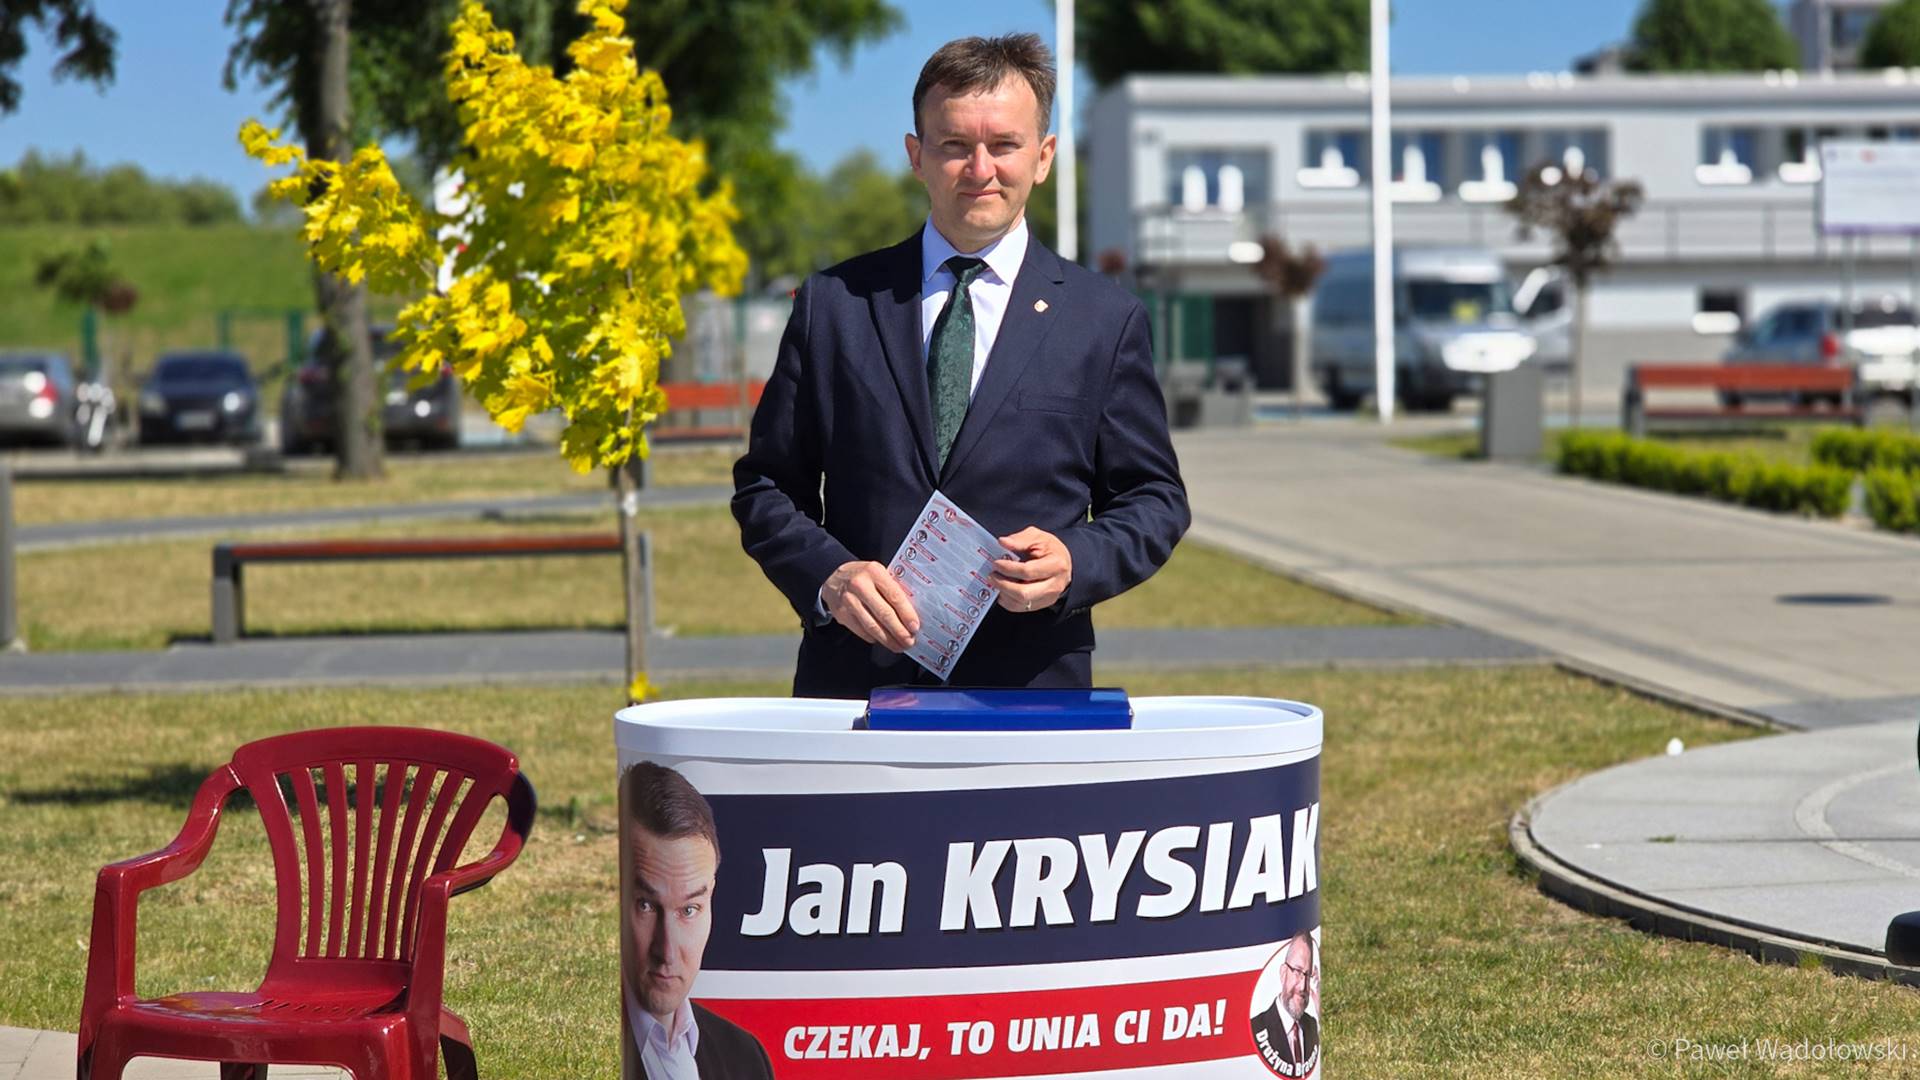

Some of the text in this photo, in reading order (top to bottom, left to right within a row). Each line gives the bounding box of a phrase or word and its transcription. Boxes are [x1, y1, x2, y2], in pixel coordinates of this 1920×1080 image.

[741, 802, 1320, 936] Jan KRYSIAK
[784, 999, 1227, 1060] CZEKAJ, TO UNIA CI DA!
[1256, 1028, 1293, 1076] Drużyna
